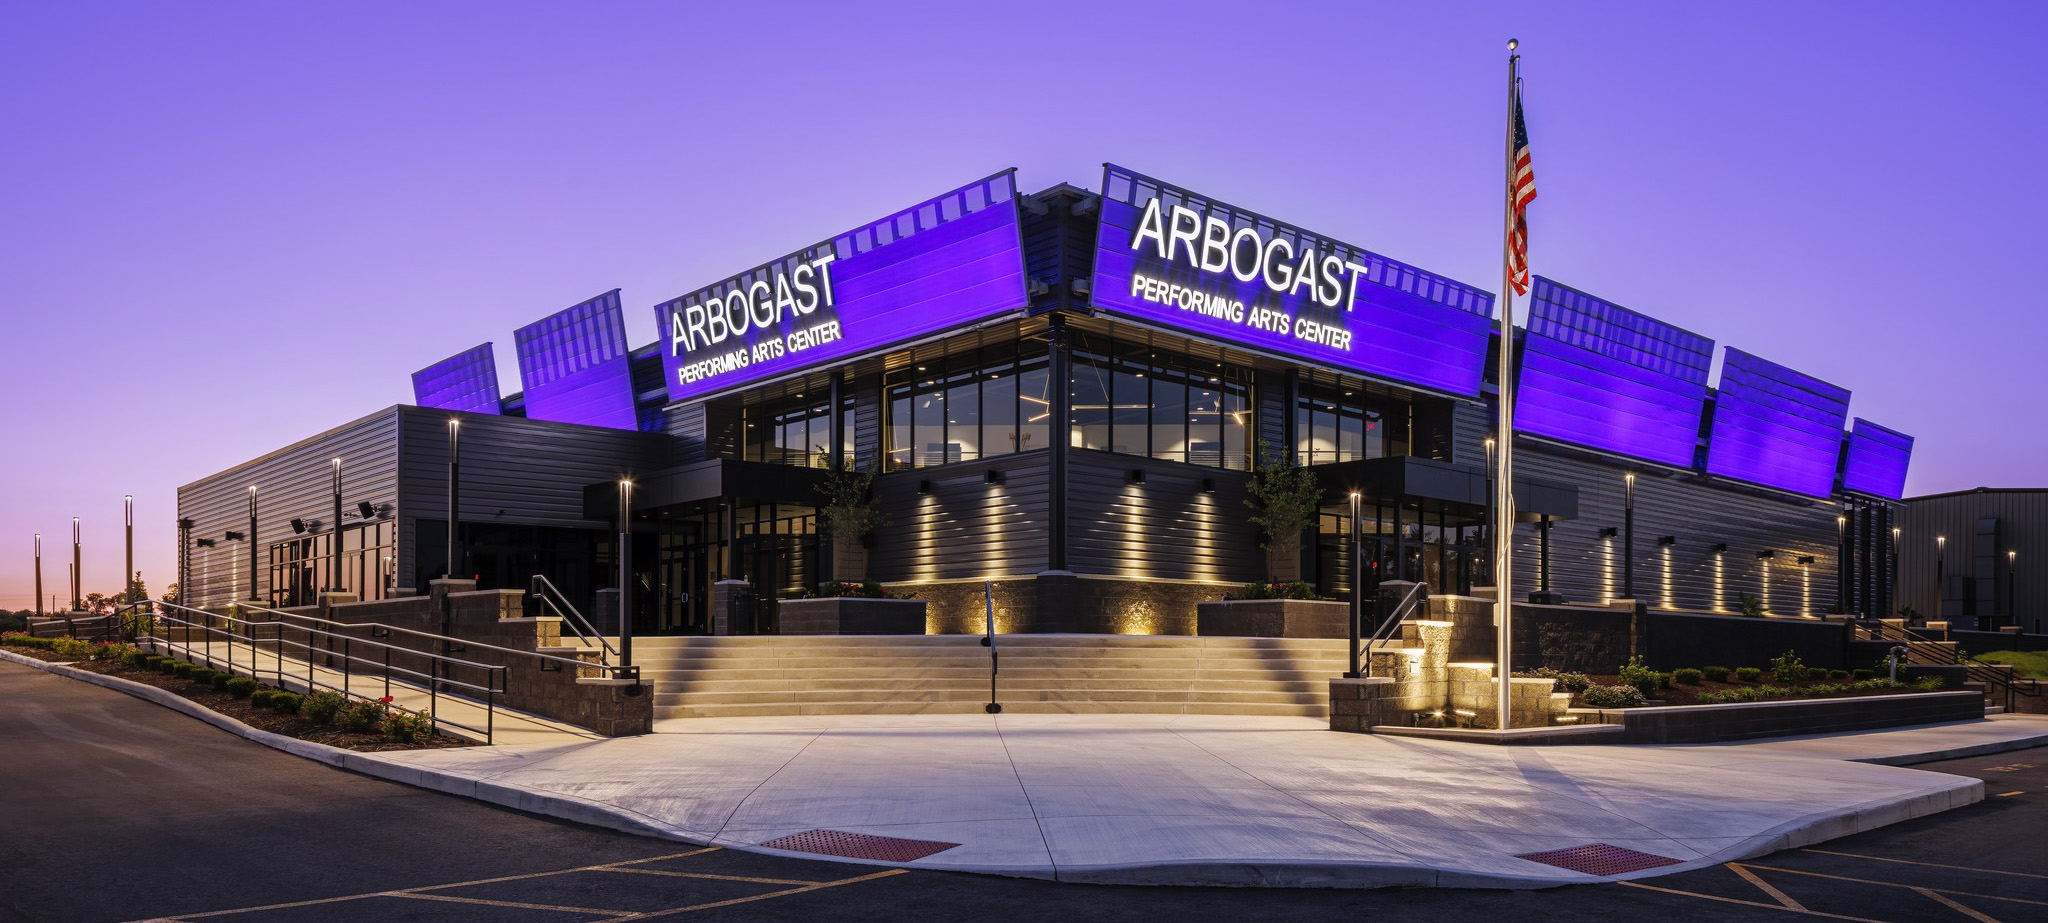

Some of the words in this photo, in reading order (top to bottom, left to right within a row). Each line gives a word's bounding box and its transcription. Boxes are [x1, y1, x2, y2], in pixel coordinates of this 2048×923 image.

[1132, 198, 1367, 312] ARBOGAST
[672, 254, 835, 357] ARBOGAST
[1132, 275, 1243, 323] PERFORMING
[1247, 307, 1289, 335] ARTS
[1295, 318, 1351, 351] CENTER
[678, 350, 749, 385] PERFORMING
[752, 338, 784, 364] ARTS
[787, 321, 841, 352] CENTER
